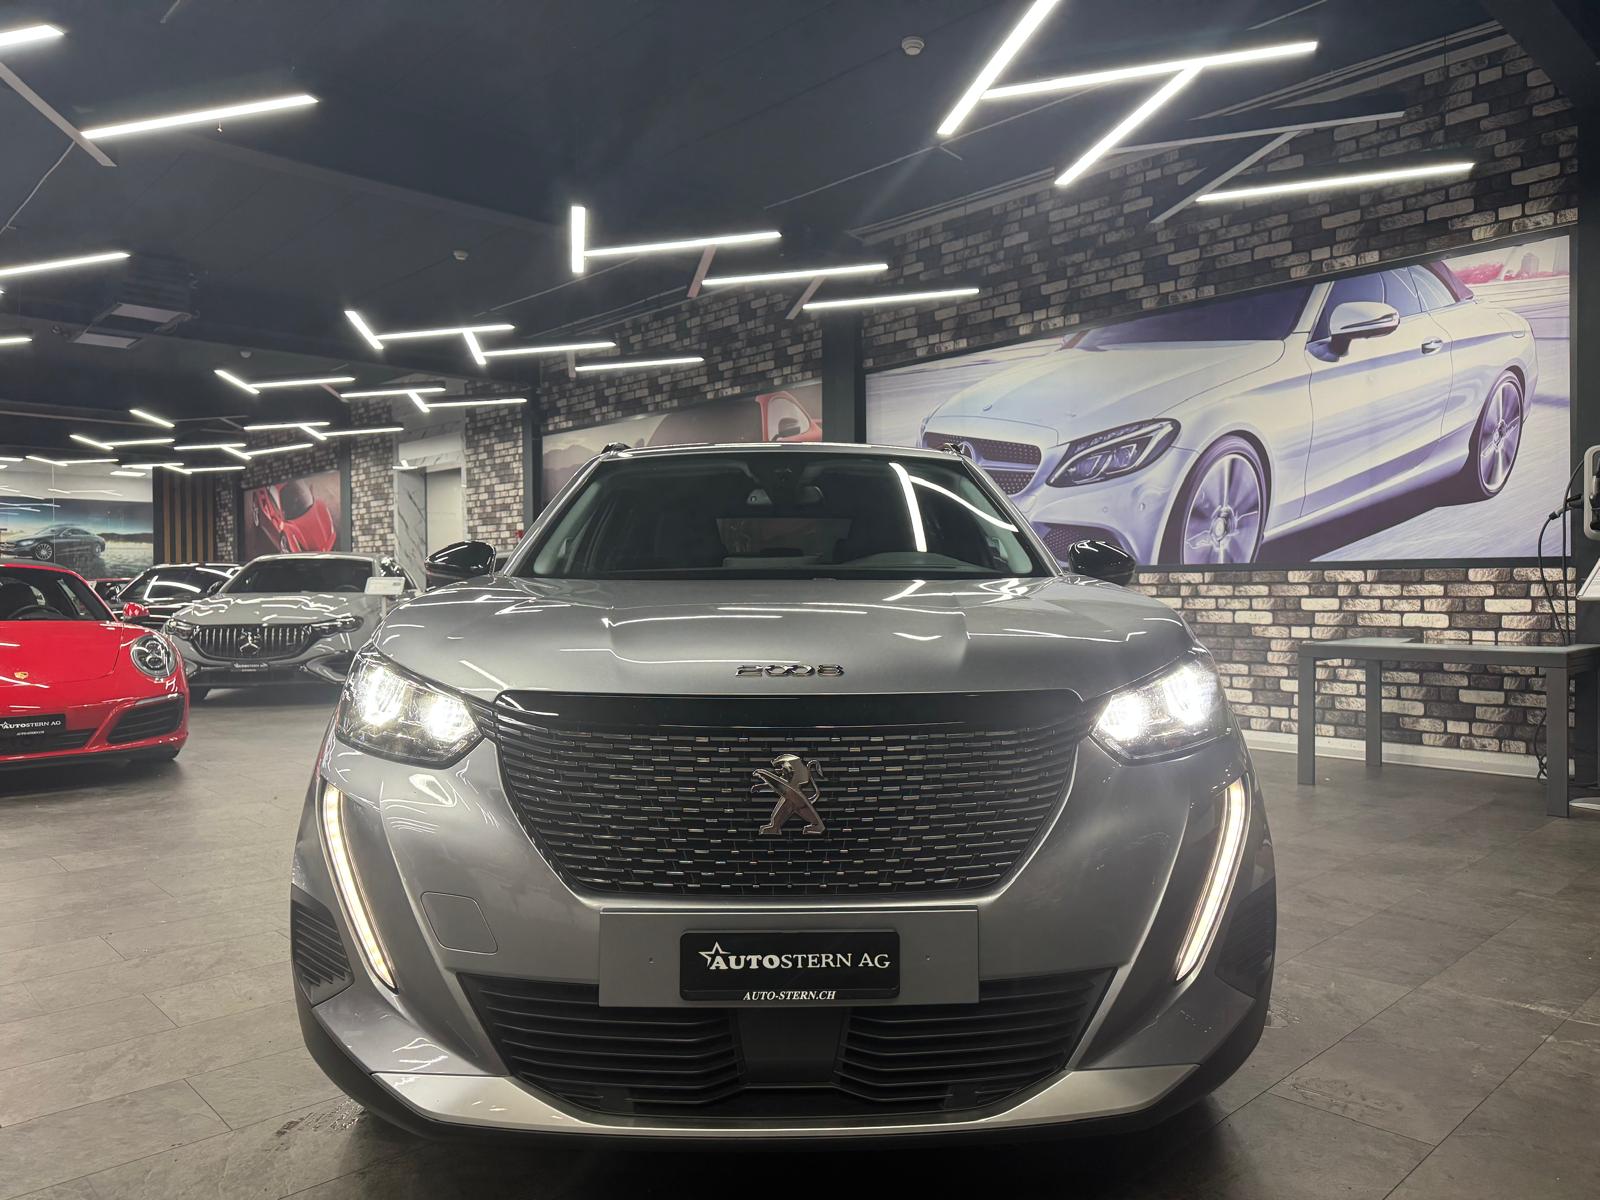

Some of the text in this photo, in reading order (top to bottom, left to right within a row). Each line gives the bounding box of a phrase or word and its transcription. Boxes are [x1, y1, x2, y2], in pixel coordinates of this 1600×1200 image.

[735, 664, 845, 677] 2008
[709, 952, 891, 970] AUTOSTERN AG
[742, 990, 837, 1001] AUTO-STERN.CH
